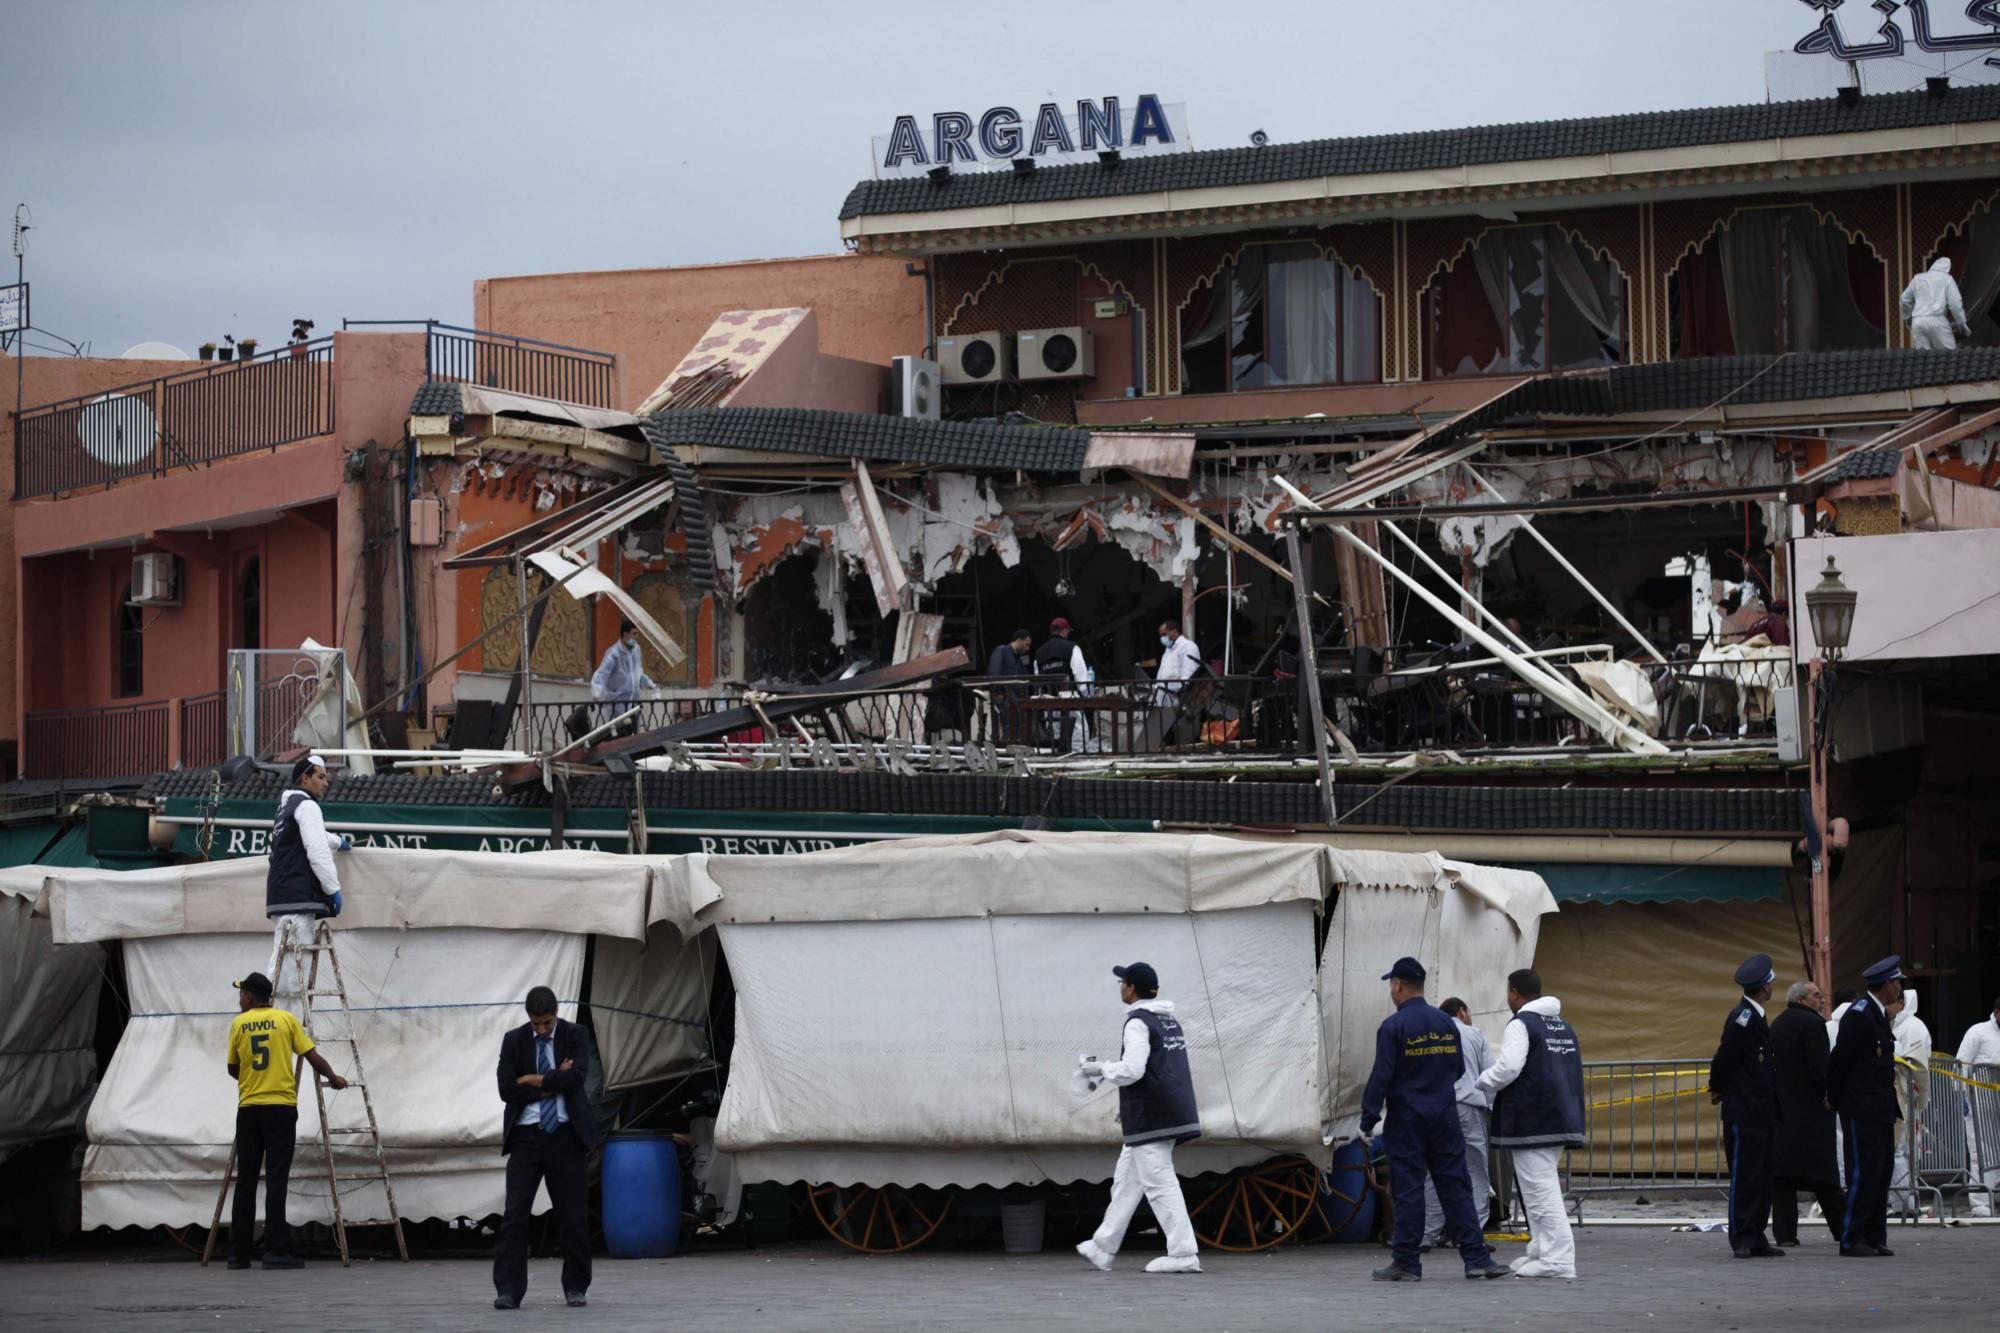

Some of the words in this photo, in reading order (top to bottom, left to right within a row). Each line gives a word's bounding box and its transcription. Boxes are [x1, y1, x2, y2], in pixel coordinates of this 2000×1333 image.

[884, 93, 1176, 168] ARGANA
[227, 828, 427, 854] REANT
[699, 836, 856, 855] RESTAU
[241, 1020, 277, 1034] PUYOL
[250, 1033, 270, 1071] 5
